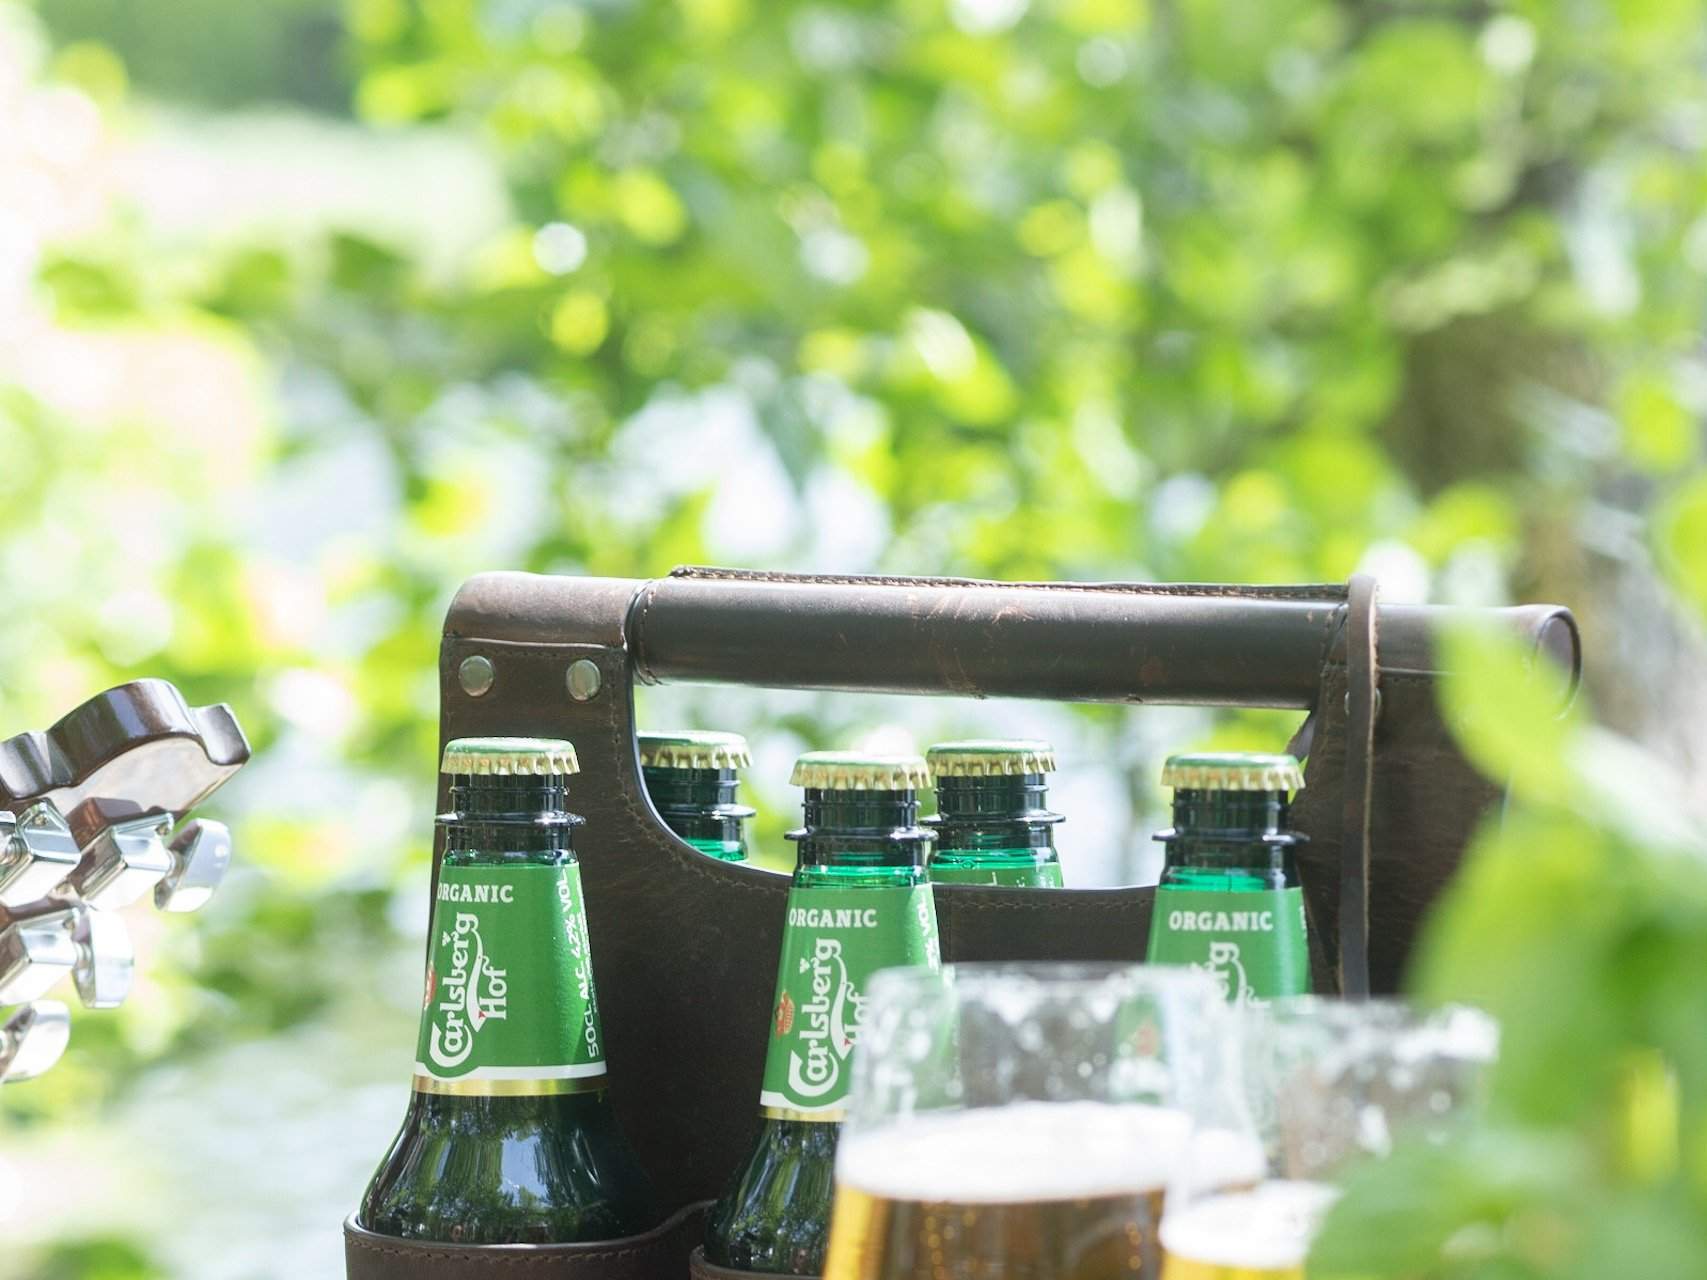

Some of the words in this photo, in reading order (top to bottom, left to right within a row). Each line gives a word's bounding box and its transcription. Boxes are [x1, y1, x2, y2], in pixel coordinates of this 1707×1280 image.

[437, 884, 514, 903] ORGANIC
[788, 908, 878, 928] ORGANIC
[1168, 911, 1273, 931] ORGANIC
[430, 912, 483, 1068] Carlsberg
[481, 955, 508, 1021] Hof
[788, 937, 847, 1097] Carlsberg
